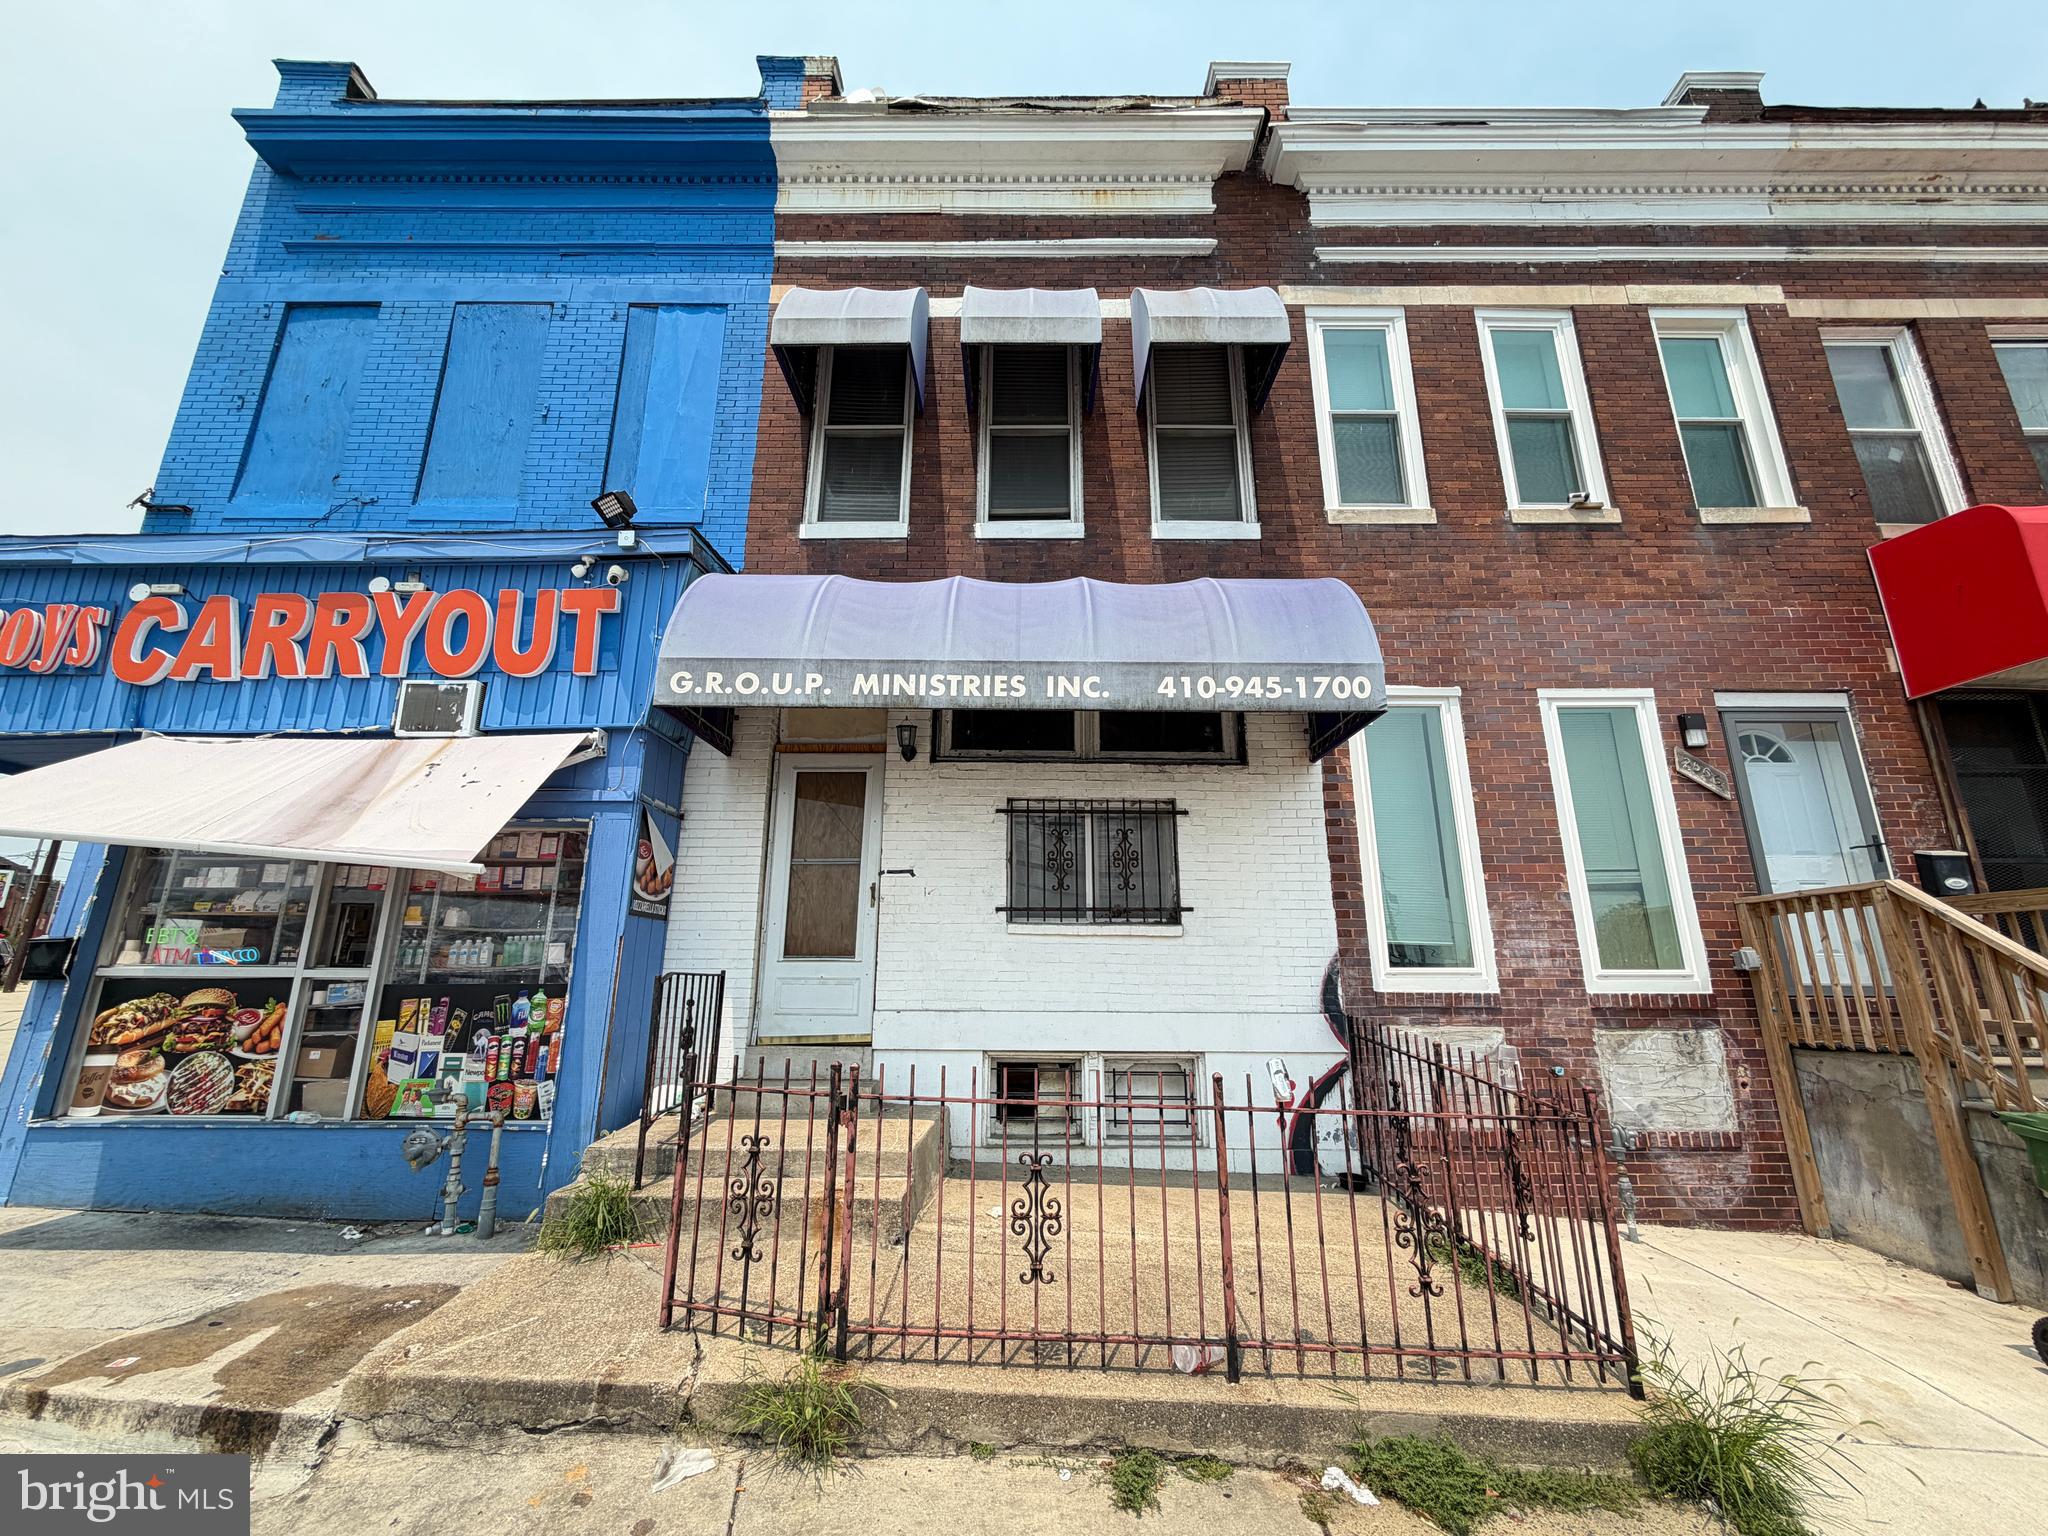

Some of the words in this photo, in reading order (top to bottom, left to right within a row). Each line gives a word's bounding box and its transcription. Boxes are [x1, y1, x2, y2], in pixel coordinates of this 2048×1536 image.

[0, 604, 110, 674] OYS
[111, 588, 621, 686] CARRYOUT
[670, 671, 832, 695] G.R.O.U.P.
[852, 673, 1027, 697] MINISTRIES
[1046, 675, 1110, 699] INC.
[1157, 676, 1372, 699] 410-945-1700
[145, 927, 181, 945] EBT
[152, 947, 191, 965] ATM
[473, 1010, 495, 1021] CAME
[465, 1069, 486, 1077] Newpo
